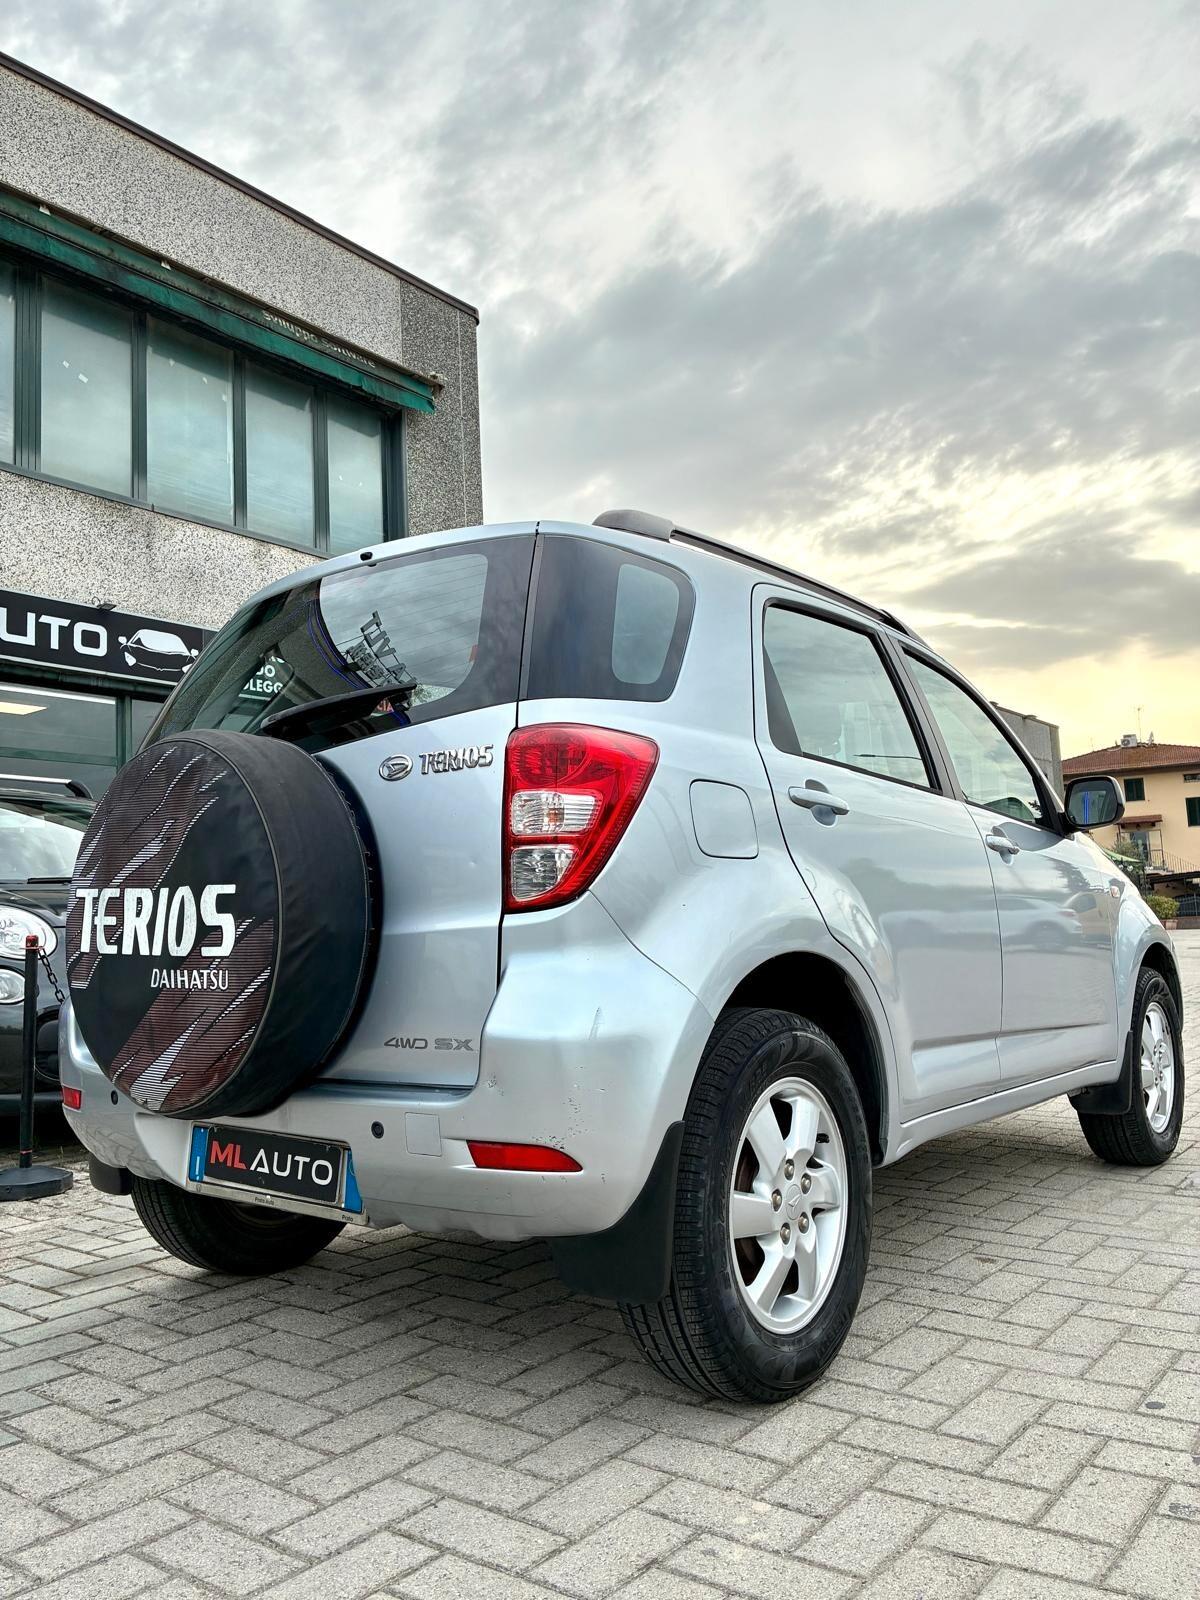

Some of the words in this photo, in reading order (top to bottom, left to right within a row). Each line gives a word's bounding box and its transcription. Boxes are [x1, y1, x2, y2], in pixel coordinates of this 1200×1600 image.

[0, 606, 108, 657] UTO
[418, 744, 494, 775] TERIOS
[75, 884, 237, 957] TERIOS
[150, 968, 229, 990] DAIHATSU
[383, 1037, 428, 1050] 4WD
[434, 1038, 474, 1051] SX
[209, 1140, 247, 1170] ML
[250, 1148, 333, 1186] AUTO
